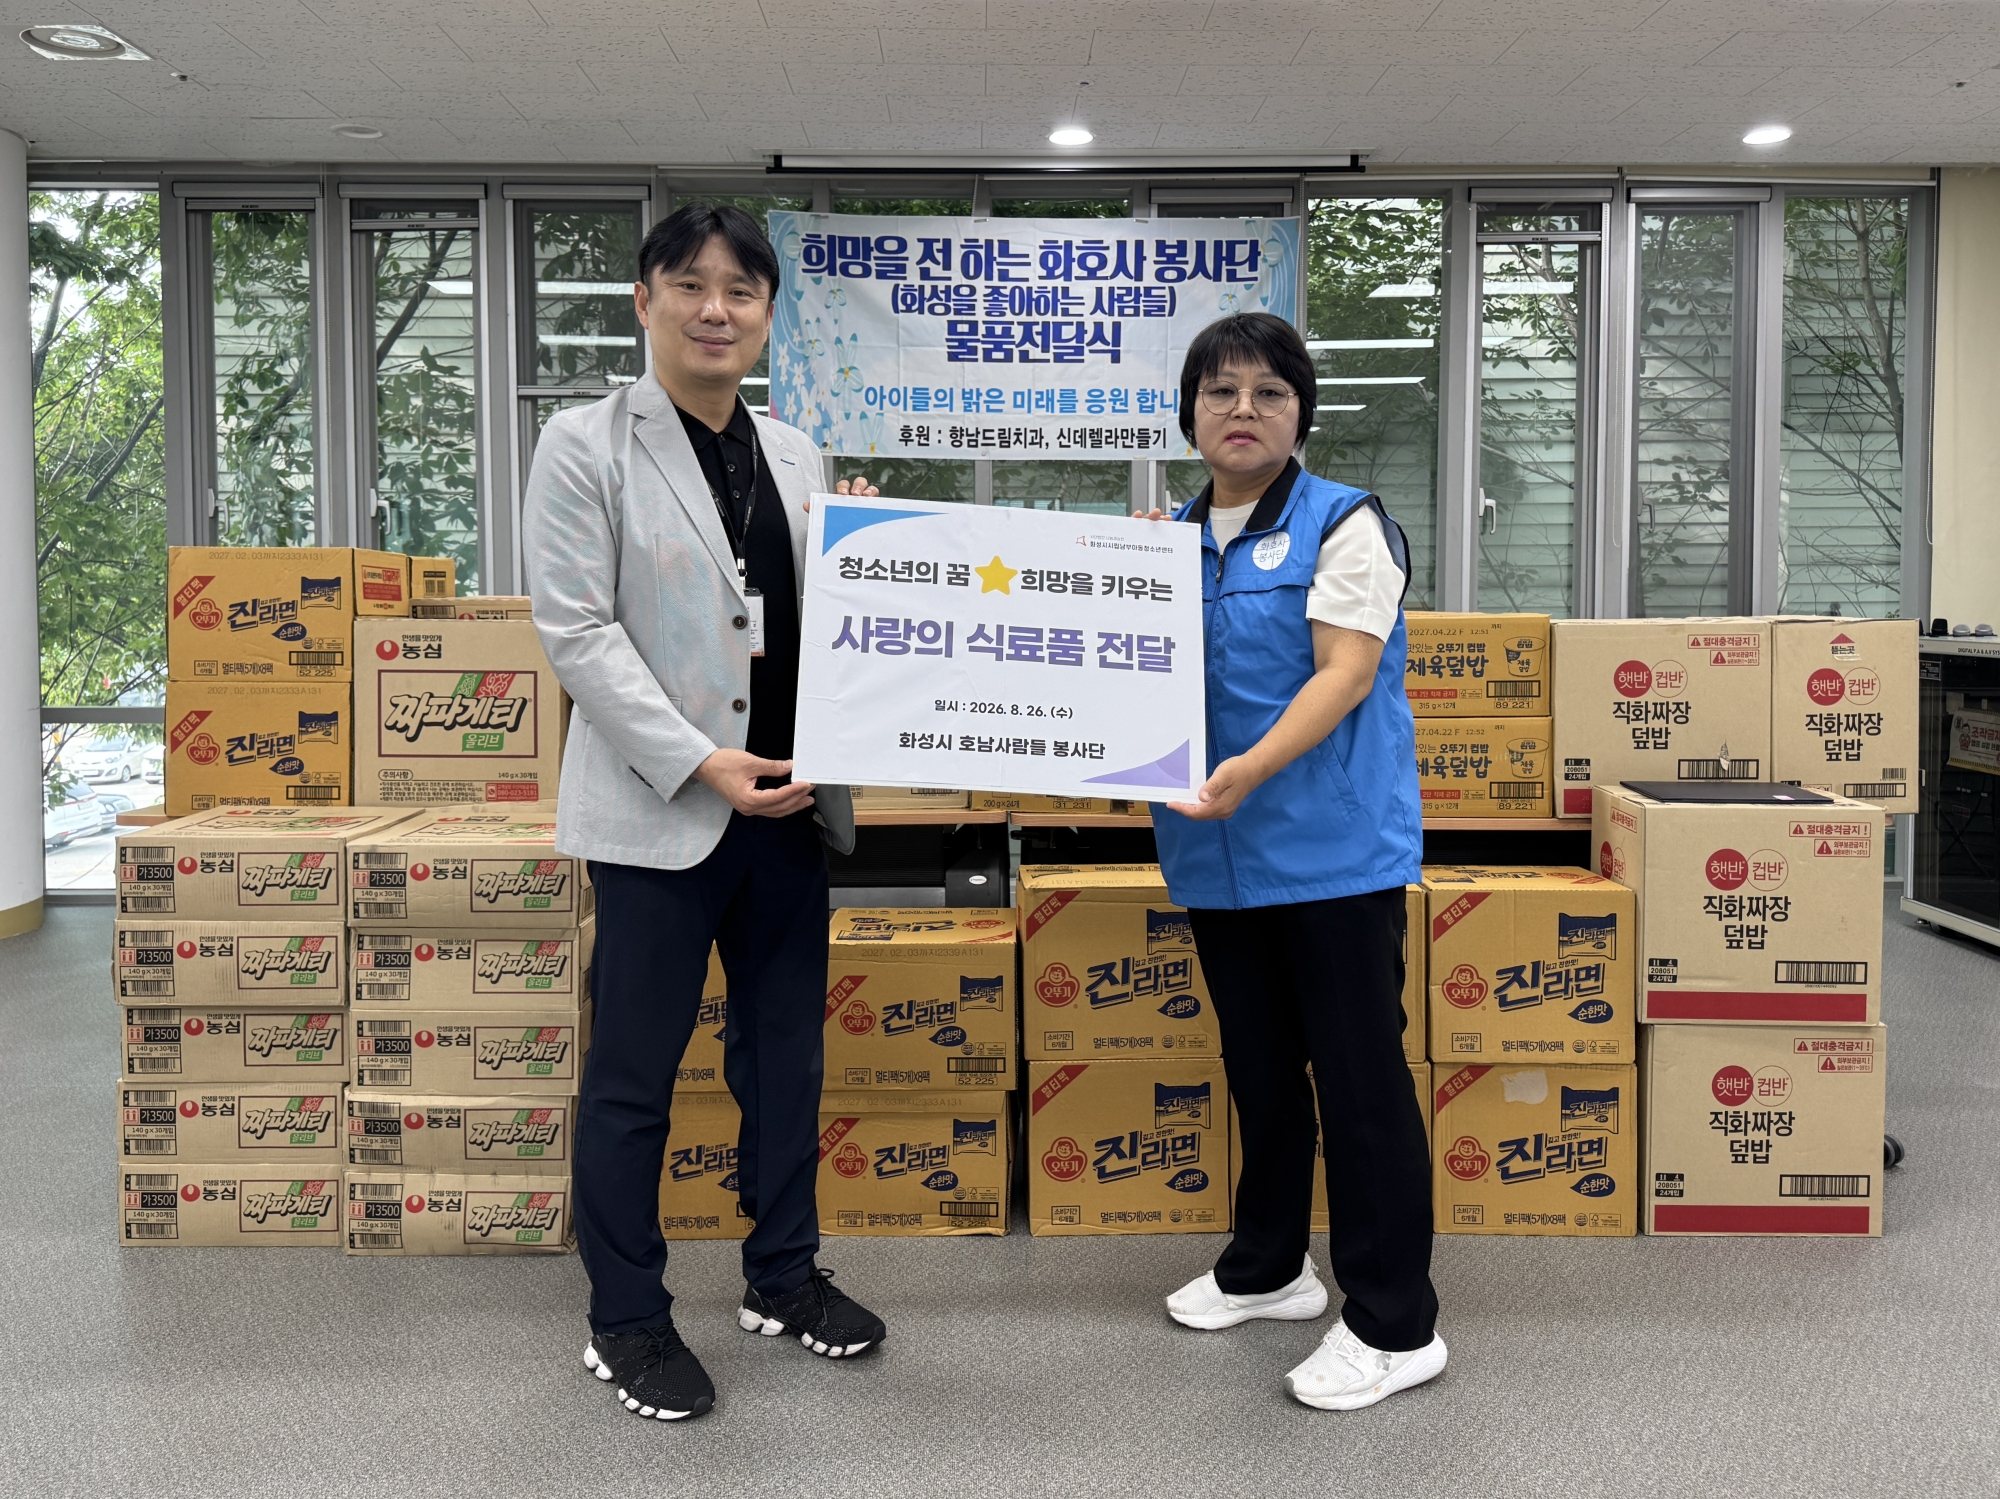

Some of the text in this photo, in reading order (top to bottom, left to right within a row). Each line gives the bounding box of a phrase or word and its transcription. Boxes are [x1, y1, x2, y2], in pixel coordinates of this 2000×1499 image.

[801, 233, 1261, 283] 희망을 전 하는 화호사 봉사단
[891, 285, 1176, 318] (화성을 좋아하는 사람들)
[946, 320, 1121, 364] 물품전달식
[864, 386, 1179, 414] 아이들의 밝은 미래를 응원 합니
[898, 425, 931, 447] 후원
[949, 427, 1049, 449] 향남드림치과,
[1056, 427, 1167, 450] 신데렐라만들기
[1261, 539, 1286, 550] 화호사
[1259, 549, 1285, 562] 봉사단
[838, 556, 1173, 601] 청소년의 꿈 희망을 키우는
[177, 579, 203, 606] 멀티팩
[196, 614, 216, 624] 오뚜기
[228, 599, 298, 632] 진라면
[279, 626, 302, 638] 순한맛
[832, 615, 1176, 673] 사랑의 식료품 전달
[1437, 643, 1464, 653] 오뚜기
[1468, 643, 1486, 653] 컵밥
[1703, 637, 1750, 646] 절대충격금지
[402, 643, 442, 659] 농심
[1406, 655, 1489, 678] 제육덮밥
[1618, 671, 1683, 689] 햇반 컵반
[1812, 679, 1876, 697] 햇반 컵반
[385, 692, 527, 742] 짜파게티
[934, 699, 958, 713] 일시
[970, 702, 1006, 715] 2026.
[1011, 704, 1022, 716] 8.
[1027, 704, 1047, 717] 26.
[1051, 706, 1073, 719] (수)
[1613, 701, 1691, 724] 직화짜장
[173, 713, 200, 741] 멀티팩
[1805, 713, 1883, 736] 직화짜장
[466, 735, 499, 748] 올리브
[899, 732, 1105, 759] 화성시 호남사람들 봉사단
[1632, 728, 1671, 749] 덮밥
[194, 750, 214, 759] 오뚜기
[225, 733, 295, 766] 진라면
[1825, 739, 1863, 761] 덮밥
[277, 761, 299, 772] 순한맛
[1806, 825, 1861, 835] 절대충격금지
[139, 866, 172, 878] 가3500
[200, 860, 234, 874] 농심
[432, 866, 467, 879] 농심
[1711, 860, 1784, 881] 햇반 컵반
[242, 865, 334, 897] 짜파게티
[371, 873, 405, 884] 가3500
[475, 872, 566, 903] 짜파게티
[293, 891, 315, 899] 올리브
[1034, 896, 1061, 923] 멀티팩
[1442, 898, 1471, 926] 멀티팩
[1703, 895, 1791, 921] 직화짜장
[1724, 925, 1768, 949] 덮밥
[138, 951, 172, 962] 가3500
[199, 943, 233, 957] 농심
[437, 946, 471, 960] 농심
[241, 949, 331, 980] 짜파게티
[376, 954, 409, 965] 가3500
[478, 953, 567, 984] 짜파게티
[1044, 987, 1071, 998] 오뚜기
[1085, 957, 1192, 1010] 진라면
[1494, 960, 1605, 1012] 진라면
[1452, 987, 1479, 999] 오뚜기
[1167, 998, 1195, 1016] 순한맛
[1578, 1004, 1607, 1020] 순한맛
[207, 1021, 241, 1034] 농심
[847, 1019, 869, 1027] 오뚜기
[881, 1000, 957, 1037] 진라면
[146, 1028, 178, 1040] 가3500
[248, 1026, 337, 1057] 짜파게티
[436, 1033, 471, 1047] 농심
[937, 1030, 961, 1043] 순한맛
[376, 1040, 410, 1052] 가3500
[479, 1039, 568, 1070] 짜파게티
[1811, 1041, 1863, 1052] 절대충격금지
[1041, 1071, 1069, 1098] 멀티팩
[1444, 1070, 1474, 1096] 멀티팩
[1717, 1077, 1788, 1096] 햇반 컵반
[142, 1110, 174, 1122] 가3500
[202, 1103, 235, 1116] 농심
[242, 1109, 331, 1139] 짜파게티
[366, 1122, 399, 1132] 가3500
[426, 1115, 461, 1128] 농심
[1709, 1111, 1795, 1136] 직화짜장
[469, 1121, 559, 1151] 짜파게티
[1093, 1131, 1200, 1184] 진라면
[1496, 1133, 1607, 1184] 진라면
[1730, 1140, 1772, 1164] 덮밥
[840, 1162, 860, 1170] 오뚜기
[874, 1143, 950, 1180] 진라면
[1052, 1160, 1078, 1172] 오뚜기
[1454, 1160, 1481, 1171] 오뚜기
[929, 1174, 953, 1188] 순한맛
[1175, 1173, 1203, 1190] 순한맛
[1580, 1177, 1609, 1194] 순한맛
[143, 1194, 176, 1206] 가3500
[202, 1187, 236, 1201] 농심
[244, 1193, 333, 1224] 짜파게티
[367, 1204, 399, 1217] 가3500
[427, 1198, 461, 1212] 농심
[468, 1205, 560, 1237] 짜파게티
[518, 1231, 540, 1240] 올리브
